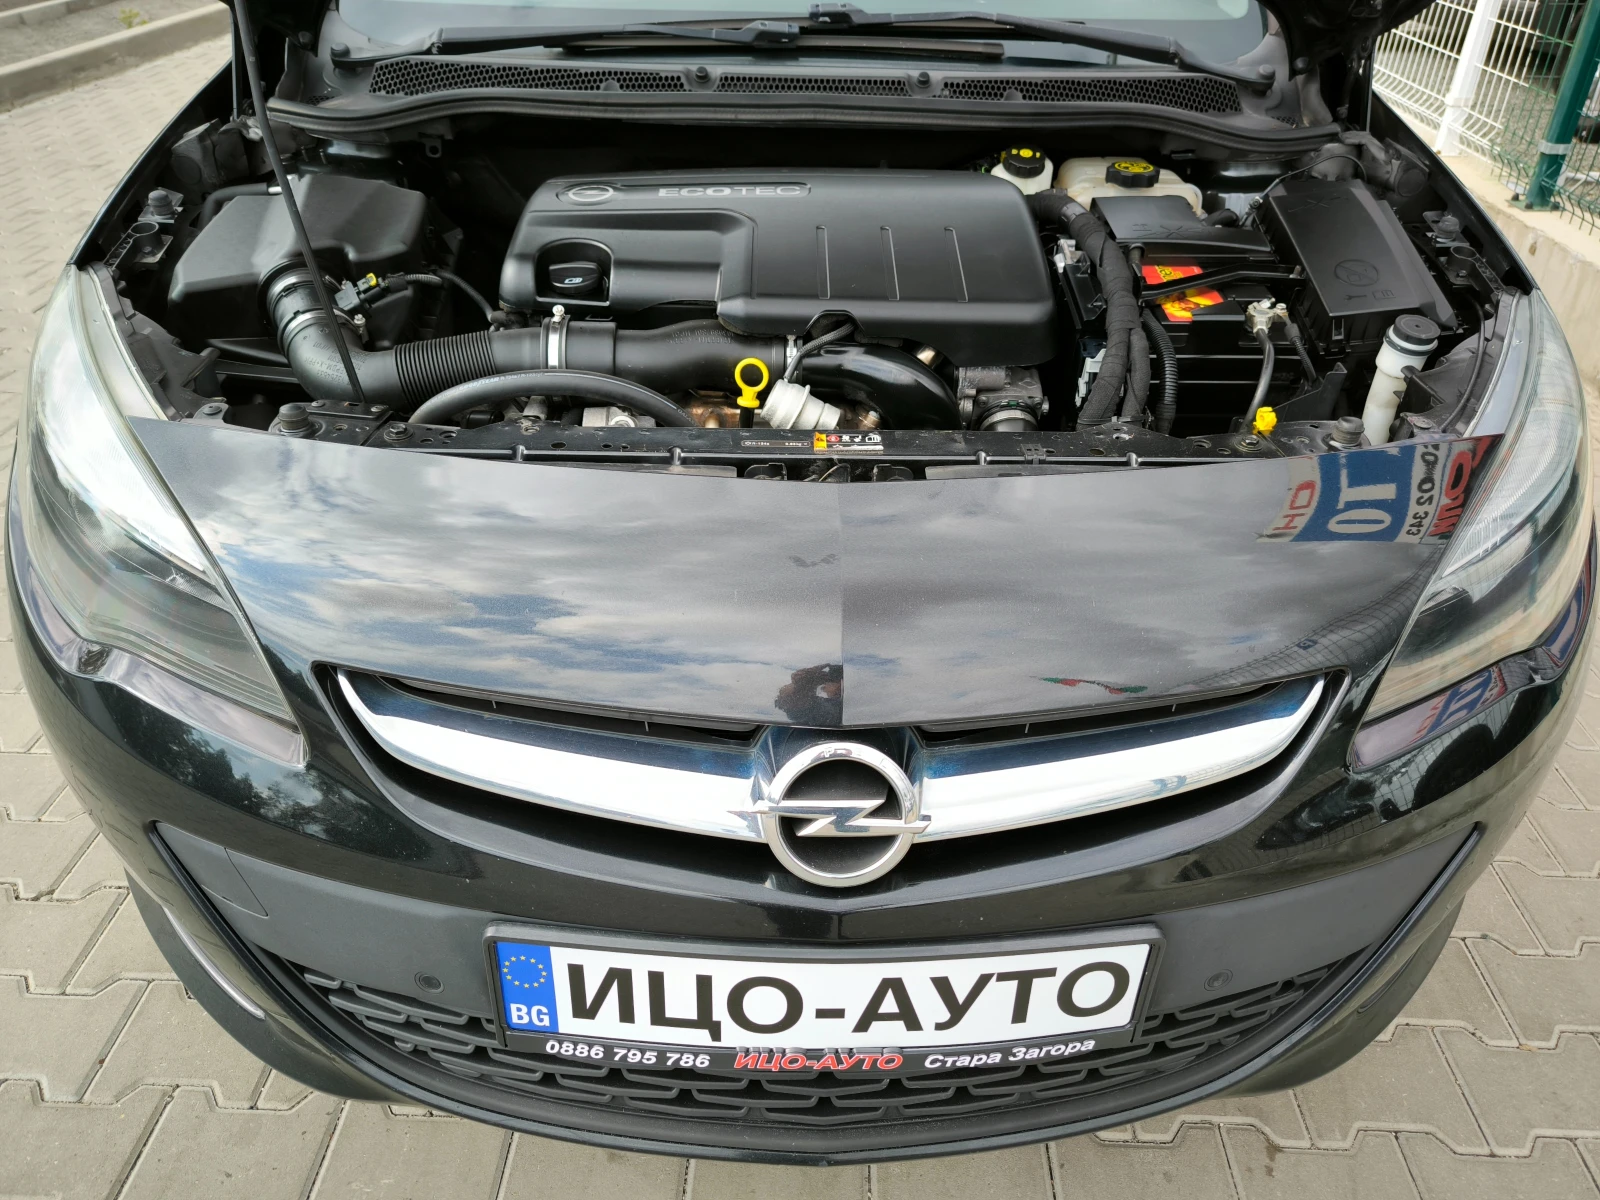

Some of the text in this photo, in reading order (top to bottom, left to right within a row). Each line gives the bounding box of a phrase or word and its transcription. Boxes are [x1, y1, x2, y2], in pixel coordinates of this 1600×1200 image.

[657, 185, 802, 197] ECOTEC
[509, 1002, 550, 1027] BG
[566, 961, 1131, 1042] ИЦО-АУТО
[545, 1040, 710, 1068] 0886 795 786
[734, 1053, 904, 1071] ИЦО-АУТО
[924, 1039, 1096, 1069] Стара Загора
